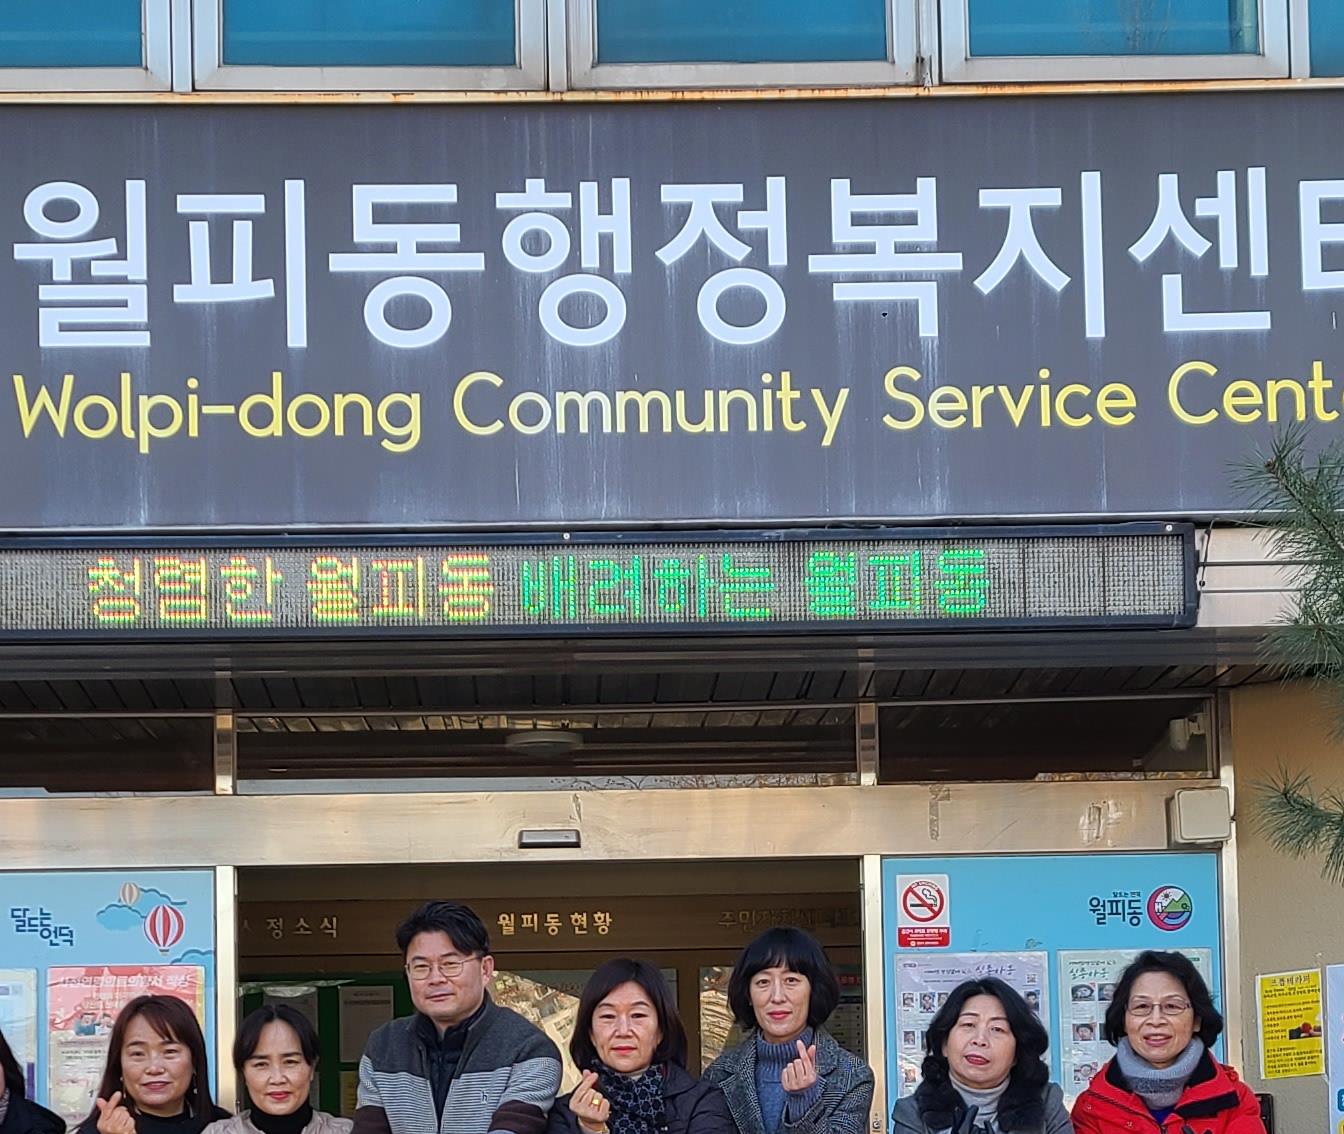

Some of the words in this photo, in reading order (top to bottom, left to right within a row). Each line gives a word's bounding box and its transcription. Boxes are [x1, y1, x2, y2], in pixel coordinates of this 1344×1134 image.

[13, 371, 421, 454] Wolpi-dong
[453, 370, 850, 446] Community
[882, 365, 1138, 431] Service
[88, 555, 284, 622] 청렴한
[306, 553, 495, 621] 월피동
[523, 553, 775, 618] 배려하는
[805, 549, 990, 616] 월피동
[497, 912, 562, 935] 월피동
[570, 910, 613, 935] 현황
[1089, 896, 1143, 927] 월피동
[39, 926, 74, 947] 언덕
